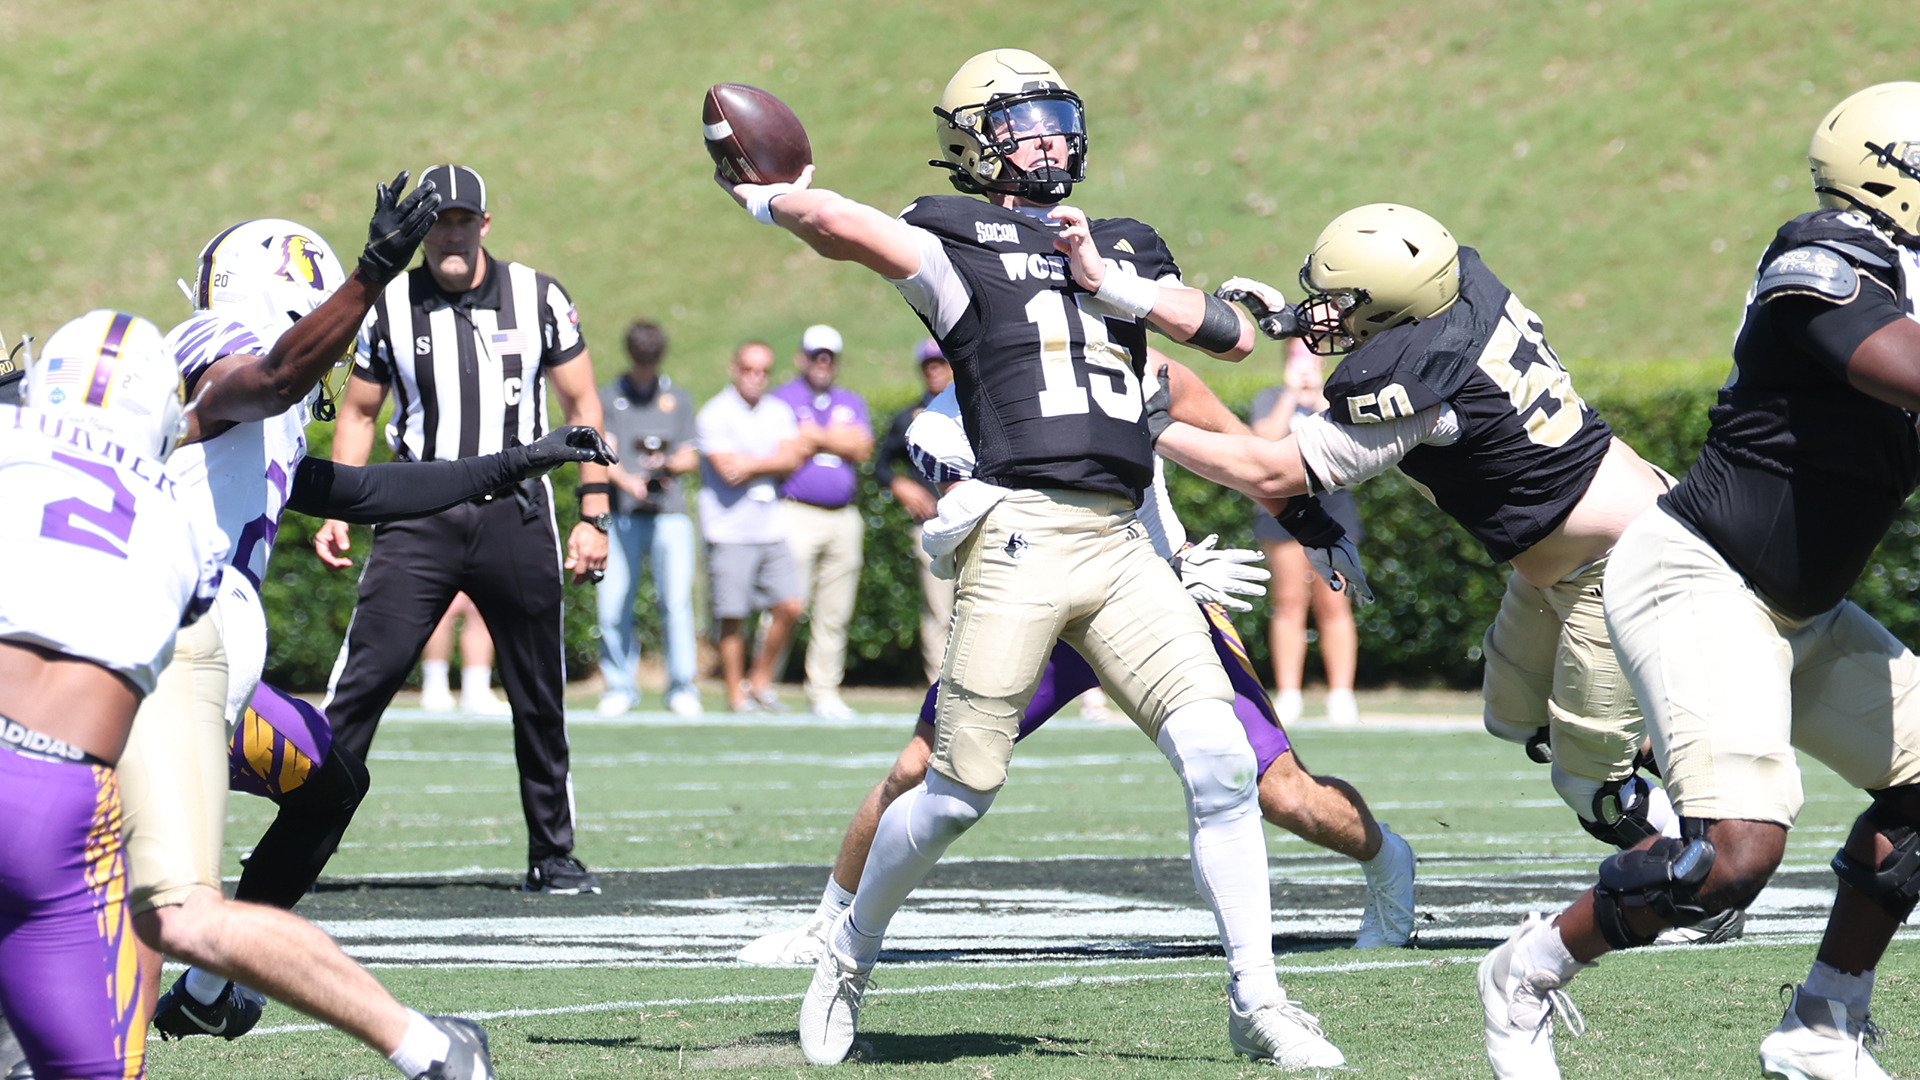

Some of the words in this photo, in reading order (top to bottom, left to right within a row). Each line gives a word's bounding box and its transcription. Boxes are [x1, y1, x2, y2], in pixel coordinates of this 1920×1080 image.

[974, 221, 1020, 244] SOCON
[213, 273, 229, 288] 20
[416, 336, 431, 355] S
[1024, 289, 1144, 424] 15
[503, 377, 522, 406] C
[1347, 383, 1415, 424] 50
[39, 450, 137, 560] 2
